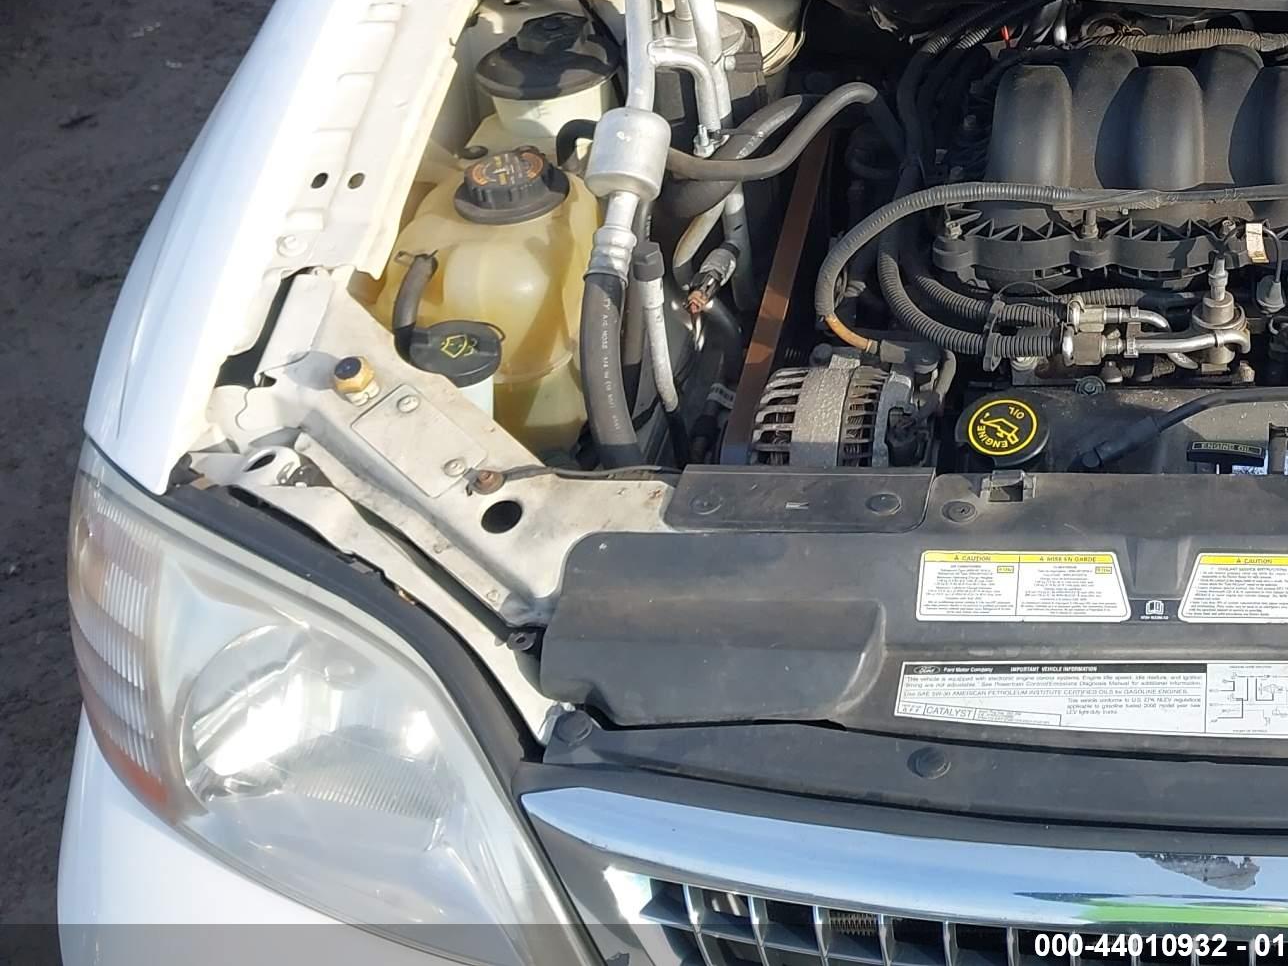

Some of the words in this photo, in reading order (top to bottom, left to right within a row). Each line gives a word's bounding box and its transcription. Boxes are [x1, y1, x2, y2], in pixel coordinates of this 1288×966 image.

[1008, 406, 1025, 419] OIL
[977, 425, 1008, 448] ENGINE
[1201, 442, 1234, 451] ENGINE
[970, 666, 993, 674] Company
[927, 705, 971, 717] CATALYST
